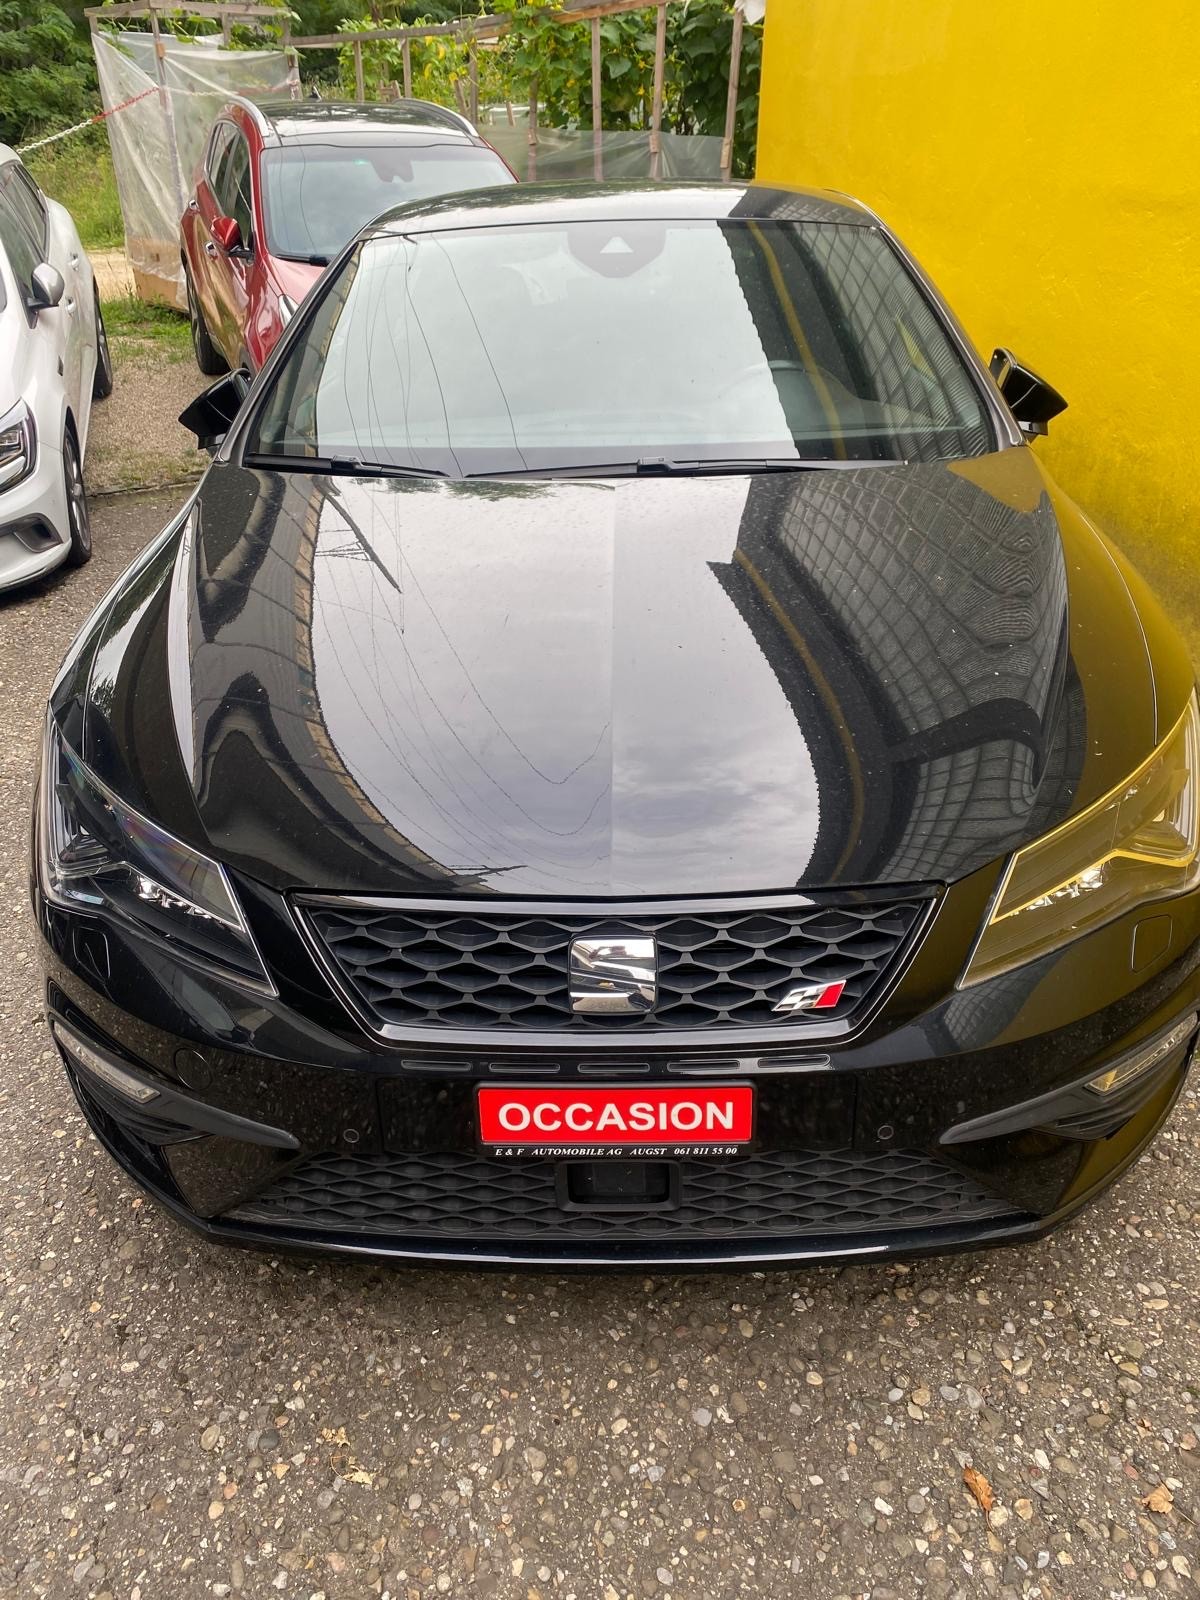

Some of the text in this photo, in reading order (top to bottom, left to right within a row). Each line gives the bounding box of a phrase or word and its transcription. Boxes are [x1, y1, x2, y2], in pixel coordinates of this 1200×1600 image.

[498, 1101, 734, 1132] OCCASION
[495, 1147, 738, 1156] E & F AUTOMOBILE AG AUGST 061 811 55 00
